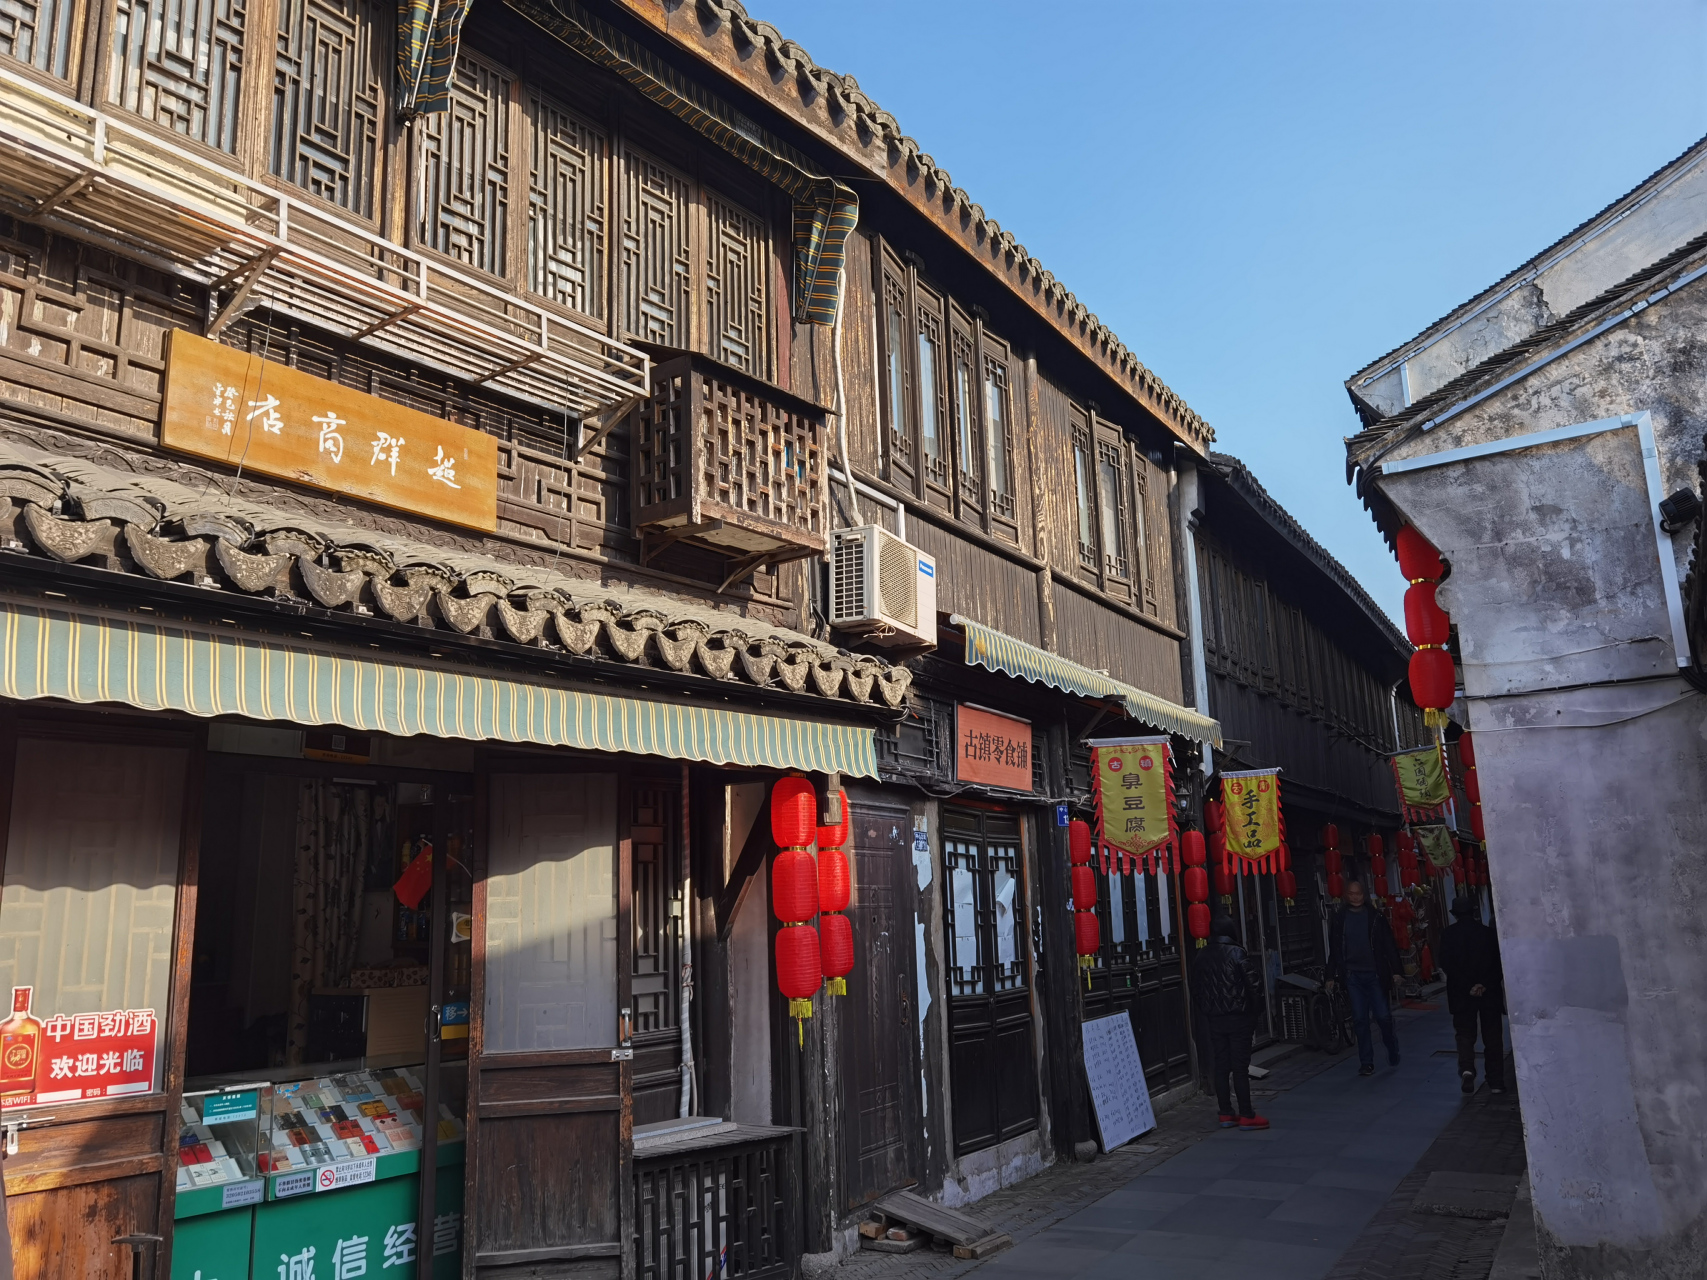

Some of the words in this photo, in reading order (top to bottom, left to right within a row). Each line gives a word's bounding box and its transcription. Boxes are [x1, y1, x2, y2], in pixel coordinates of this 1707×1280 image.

[1121, 772, 1146, 833] 臭豆腐
[1241, 789, 1262, 848] 手工品
[46, 1011, 153, 1043] 中国劲酒
[445, 1006, 457, 1020] 移
[49, 1048, 145, 1080] 欢迎光临
[277, 1211, 461, 1280] 诚信经营
